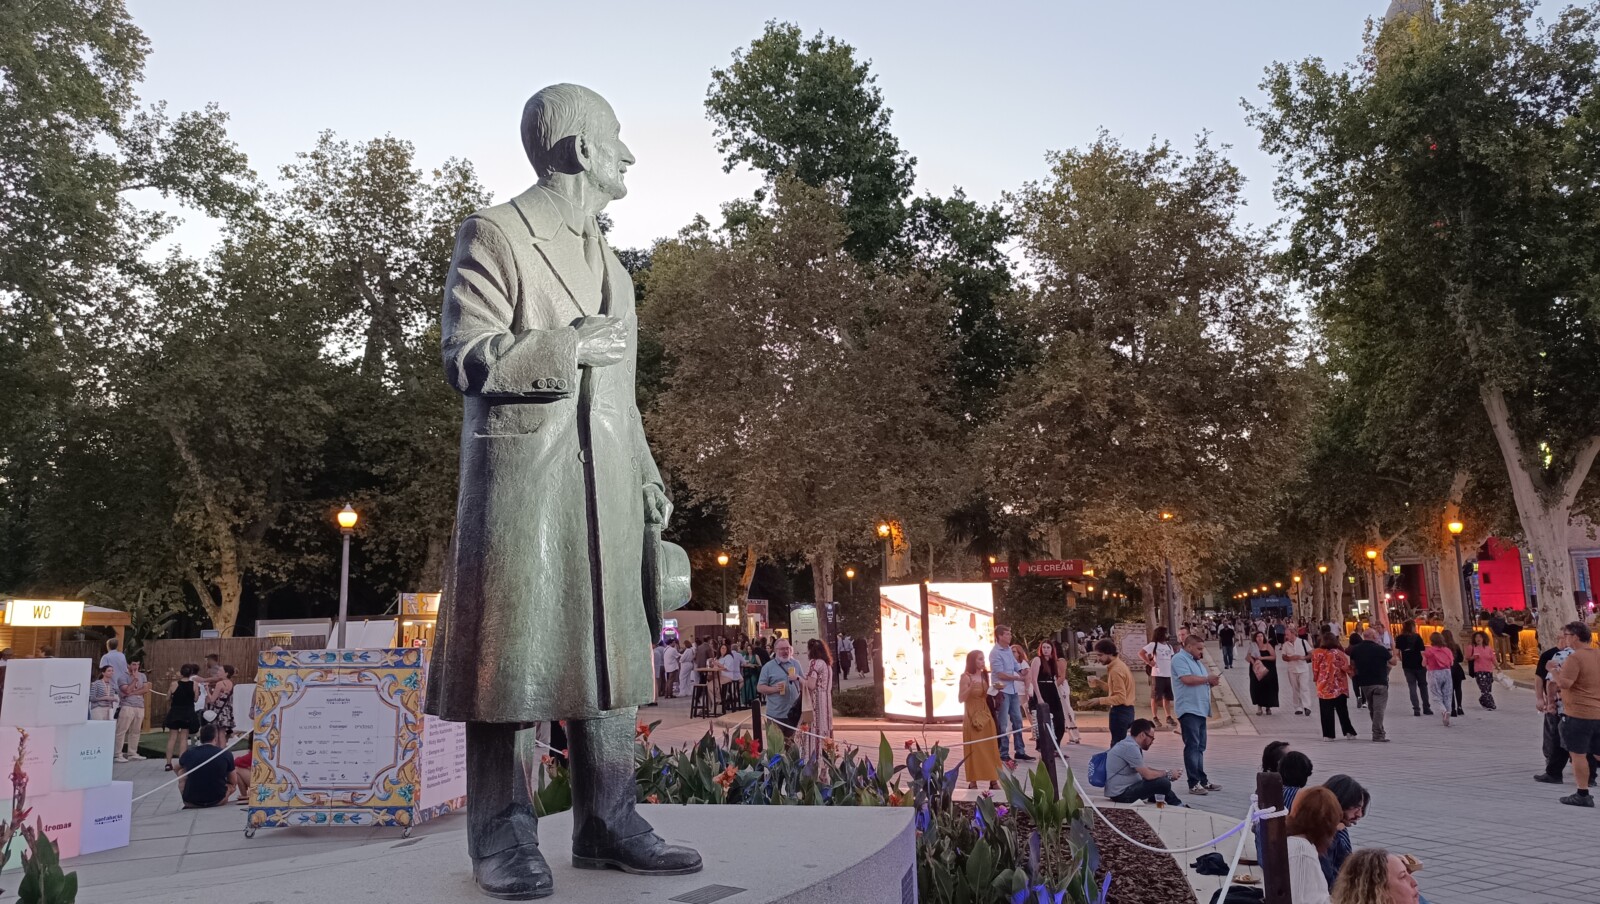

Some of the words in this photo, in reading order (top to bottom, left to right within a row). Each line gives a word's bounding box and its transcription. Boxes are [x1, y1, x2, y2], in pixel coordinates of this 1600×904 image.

[1028, 564, 1042, 572] ICE
[1044, 563, 1073, 572] CREAM
[33, 605, 51, 619] WC
[80, 746, 102, 756] MELIÁ
